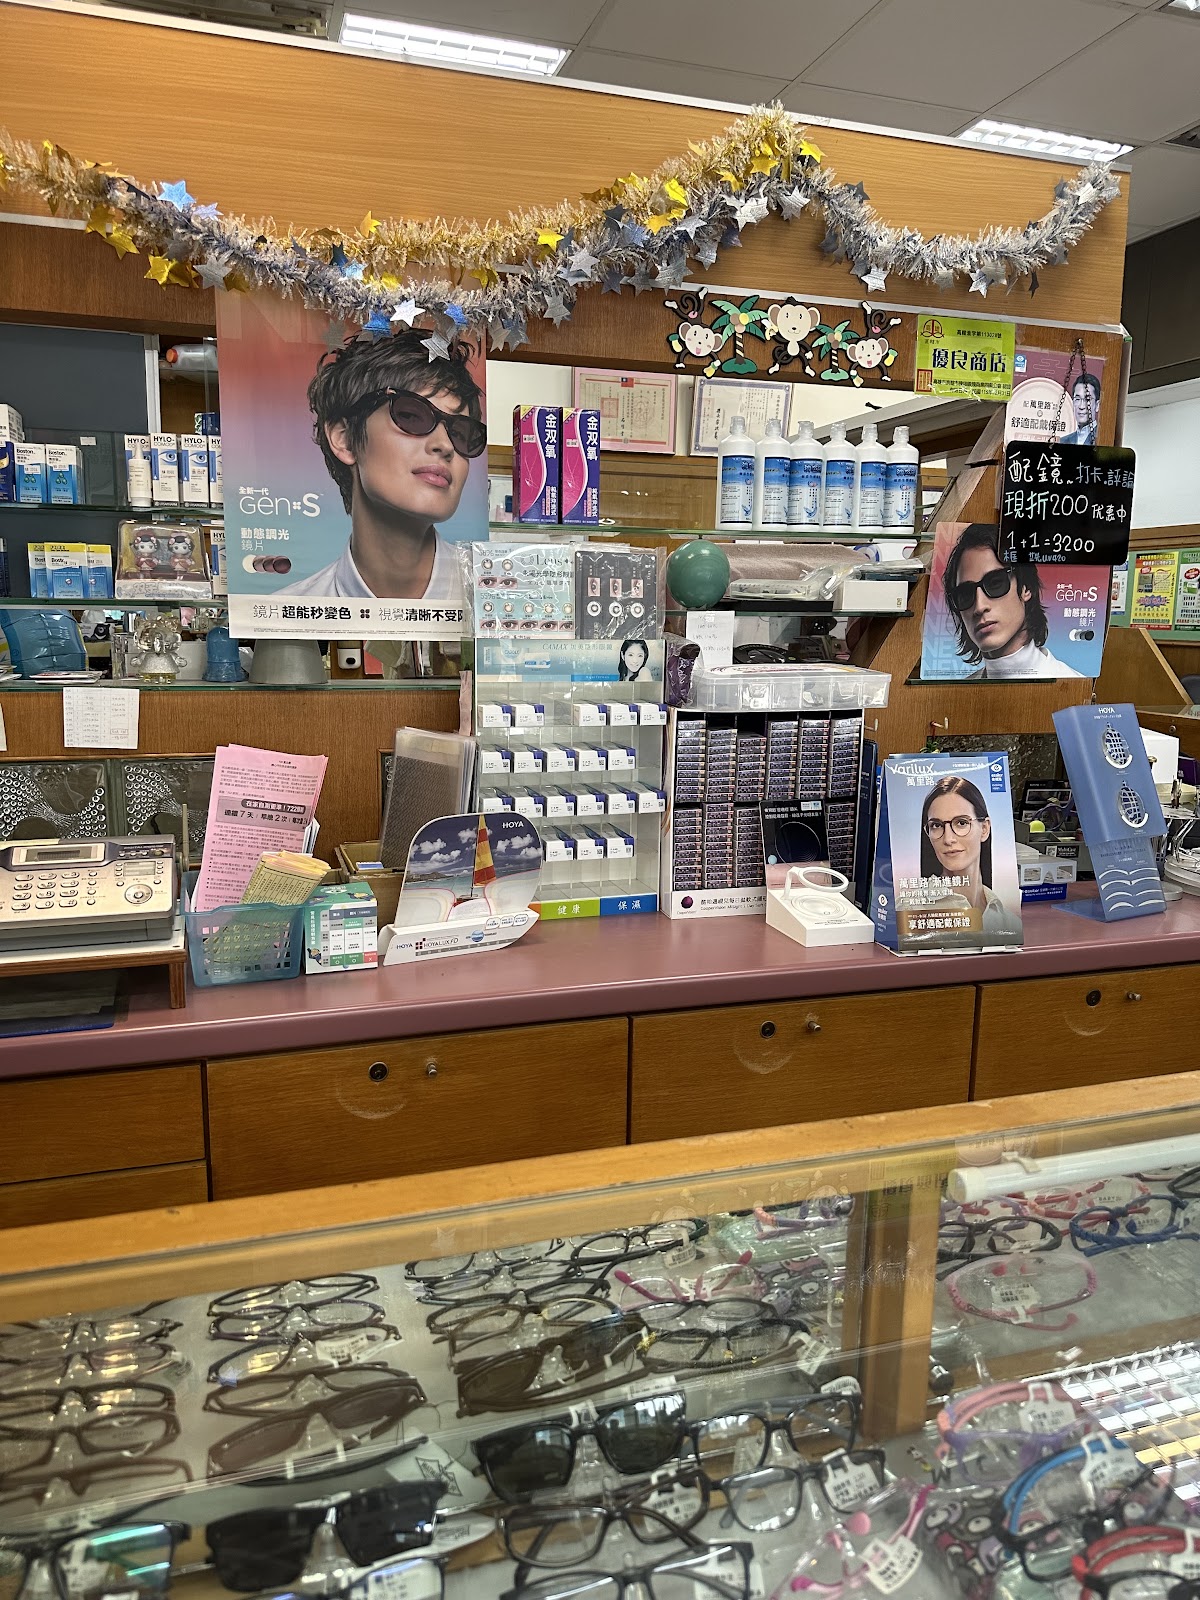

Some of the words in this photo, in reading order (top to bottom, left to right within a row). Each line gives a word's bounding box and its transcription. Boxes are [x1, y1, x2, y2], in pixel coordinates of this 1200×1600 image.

[932, 348, 1007, 373] 優良商店
[153, 435, 175, 443] HYLO-
[239, 487, 269, 496] 全新一代
[241, 527, 290, 541] 動態調光
[241, 540, 264, 552] 鏡片
[1063, 607, 1097, 618] 動態調光
[1079, 617, 1094, 627] 鏡片
[502, 820, 524, 829] HOYA
[899, 877, 928, 888] 萬里路
[932, 875, 970, 888] 漸進鏡片
[557, 905, 582, 915] 健康
[908, 917, 971, 930] 享舒適配戴保證
[396, 942, 413, 950] HOYA
